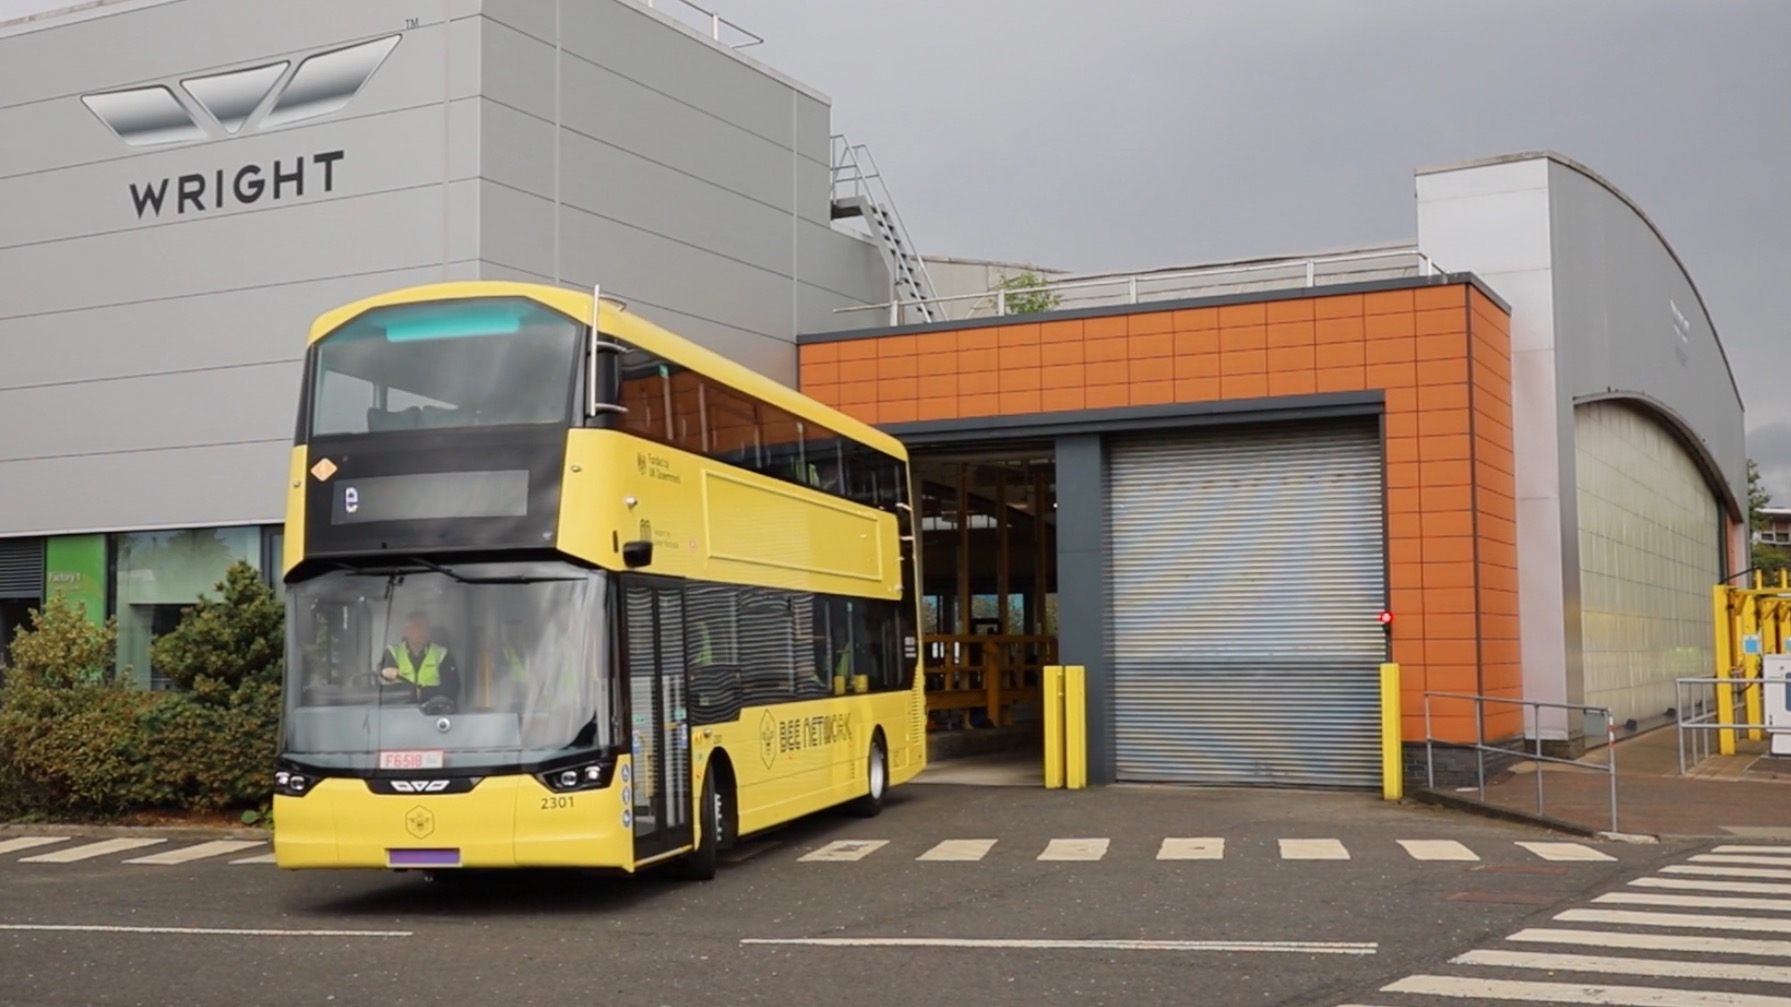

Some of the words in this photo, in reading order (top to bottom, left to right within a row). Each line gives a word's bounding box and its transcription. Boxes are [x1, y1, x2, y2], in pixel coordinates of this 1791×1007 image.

[128, 150, 345, 220] WRIGHT
[779, 718, 801, 753] BEE
[540, 796, 574, 810] 2301
